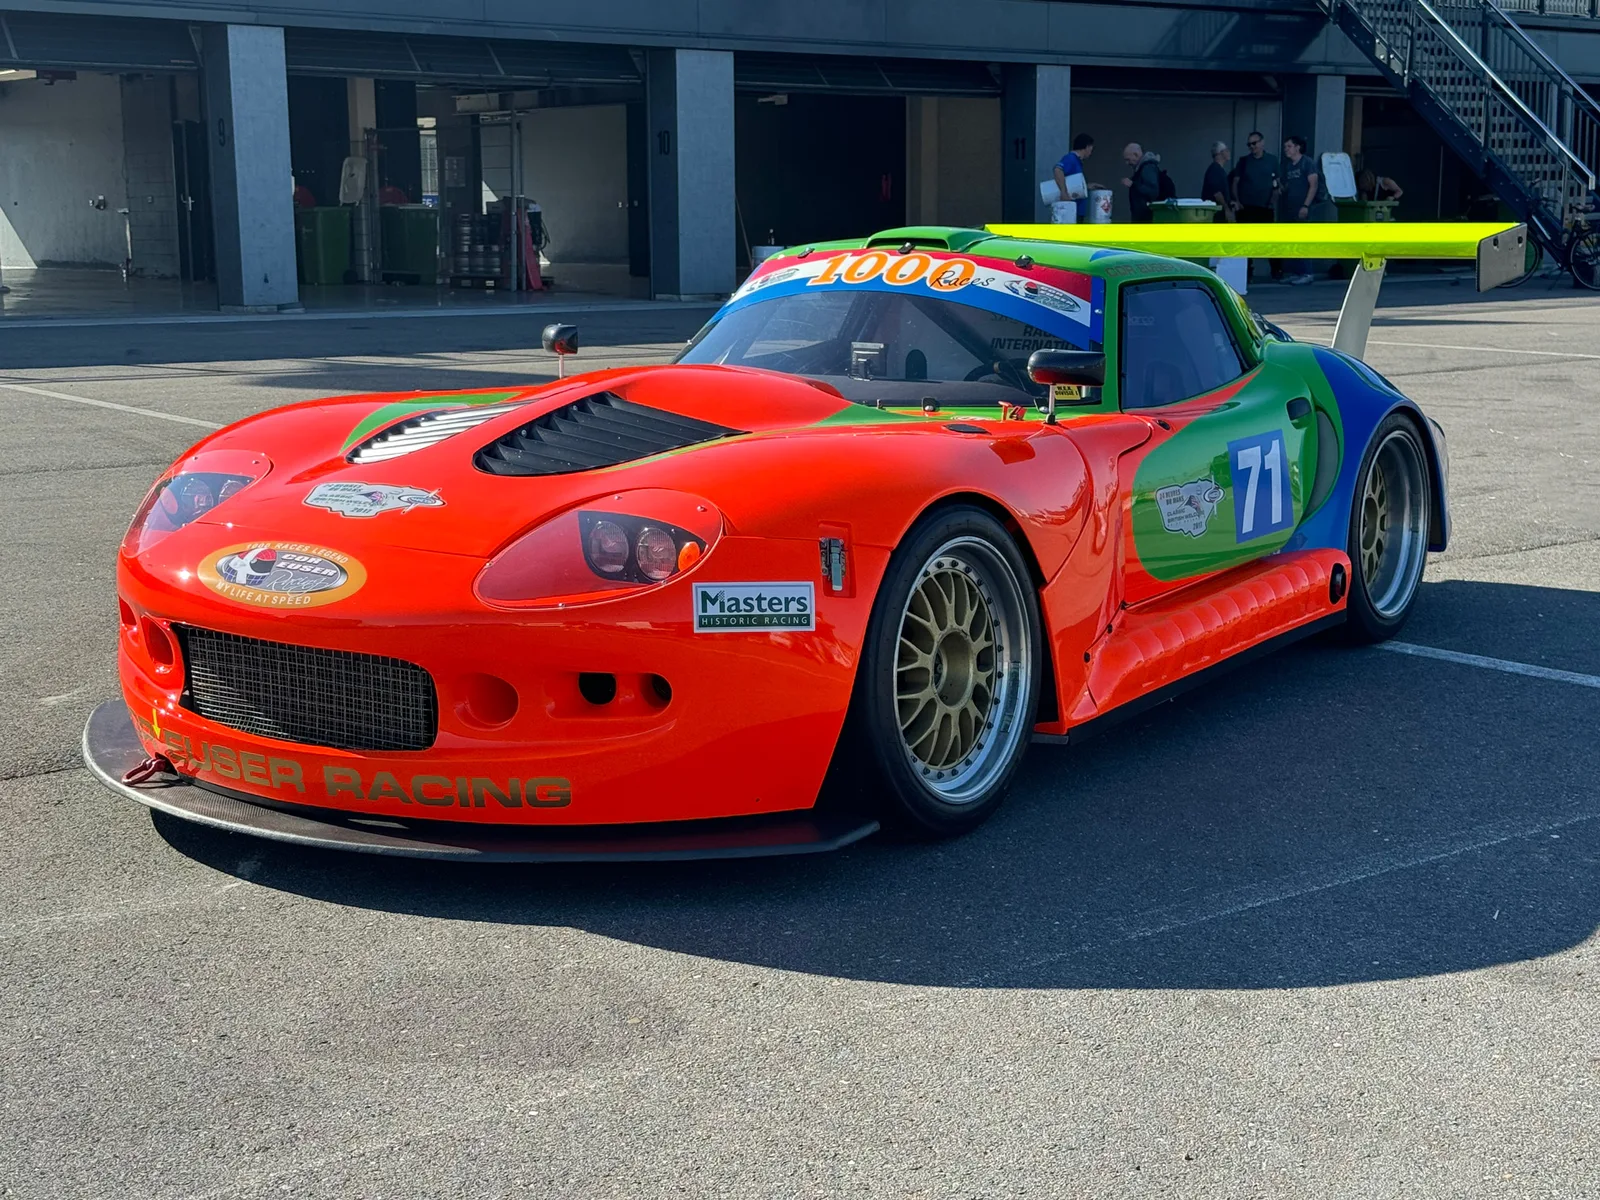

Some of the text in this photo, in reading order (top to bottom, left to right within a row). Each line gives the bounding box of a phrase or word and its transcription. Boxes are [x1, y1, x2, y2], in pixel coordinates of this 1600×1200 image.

[217, 117, 226, 147] 9
[656, 129, 671, 156] 10
[1012, 137, 1027, 160] 11
[806, 251, 978, 292] 1000
[930, 269, 996, 288] Races
[1237, 439, 1283, 534] 71
[274, 543, 309, 552] RACES
[312, 547, 349, 564] LEGEND
[275, 561, 338, 577] EUSER
[215, 582, 311, 605] MY LIFE AT SPEED
[700, 590, 808, 613] Masters
[701, 616, 808, 625] HISTORIC RACING
[163, 728, 307, 793] EUSER
[323, 765, 572, 808] RACING
